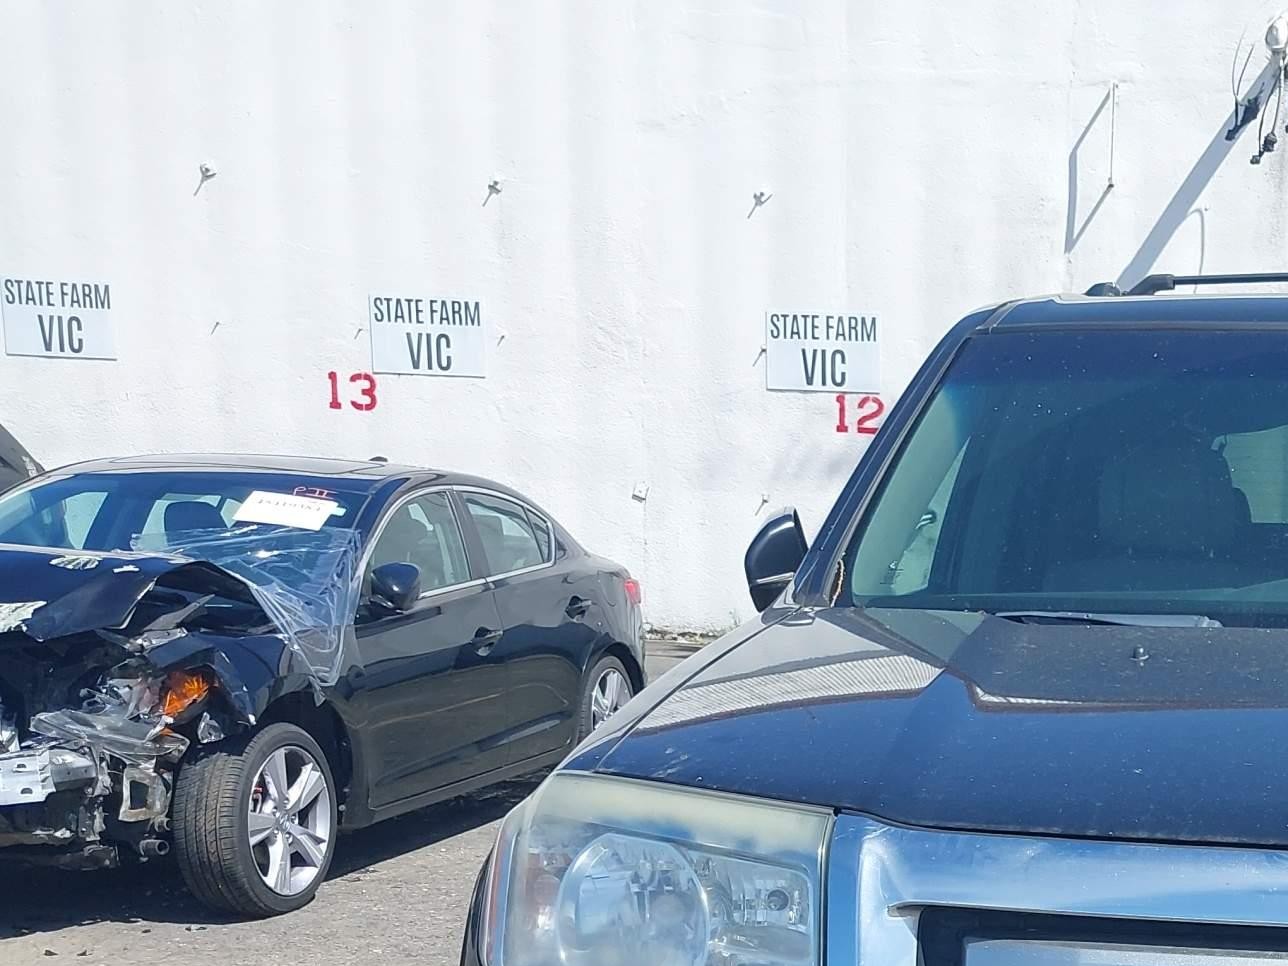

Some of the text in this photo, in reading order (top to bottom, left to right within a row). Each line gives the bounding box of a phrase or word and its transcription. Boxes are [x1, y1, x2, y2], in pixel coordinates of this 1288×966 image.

[4, 278, 111, 310] STATE FARM
[373, 297, 481, 327] STATE FARM
[37, 314, 84, 354] VIC
[770, 313, 877, 342] STATE FARM
[406, 332, 452, 371] VIC
[801, 347, 847, 388] VIC
[328, 371, 377, 411] 13
[836, 394, 885, 435] 12
